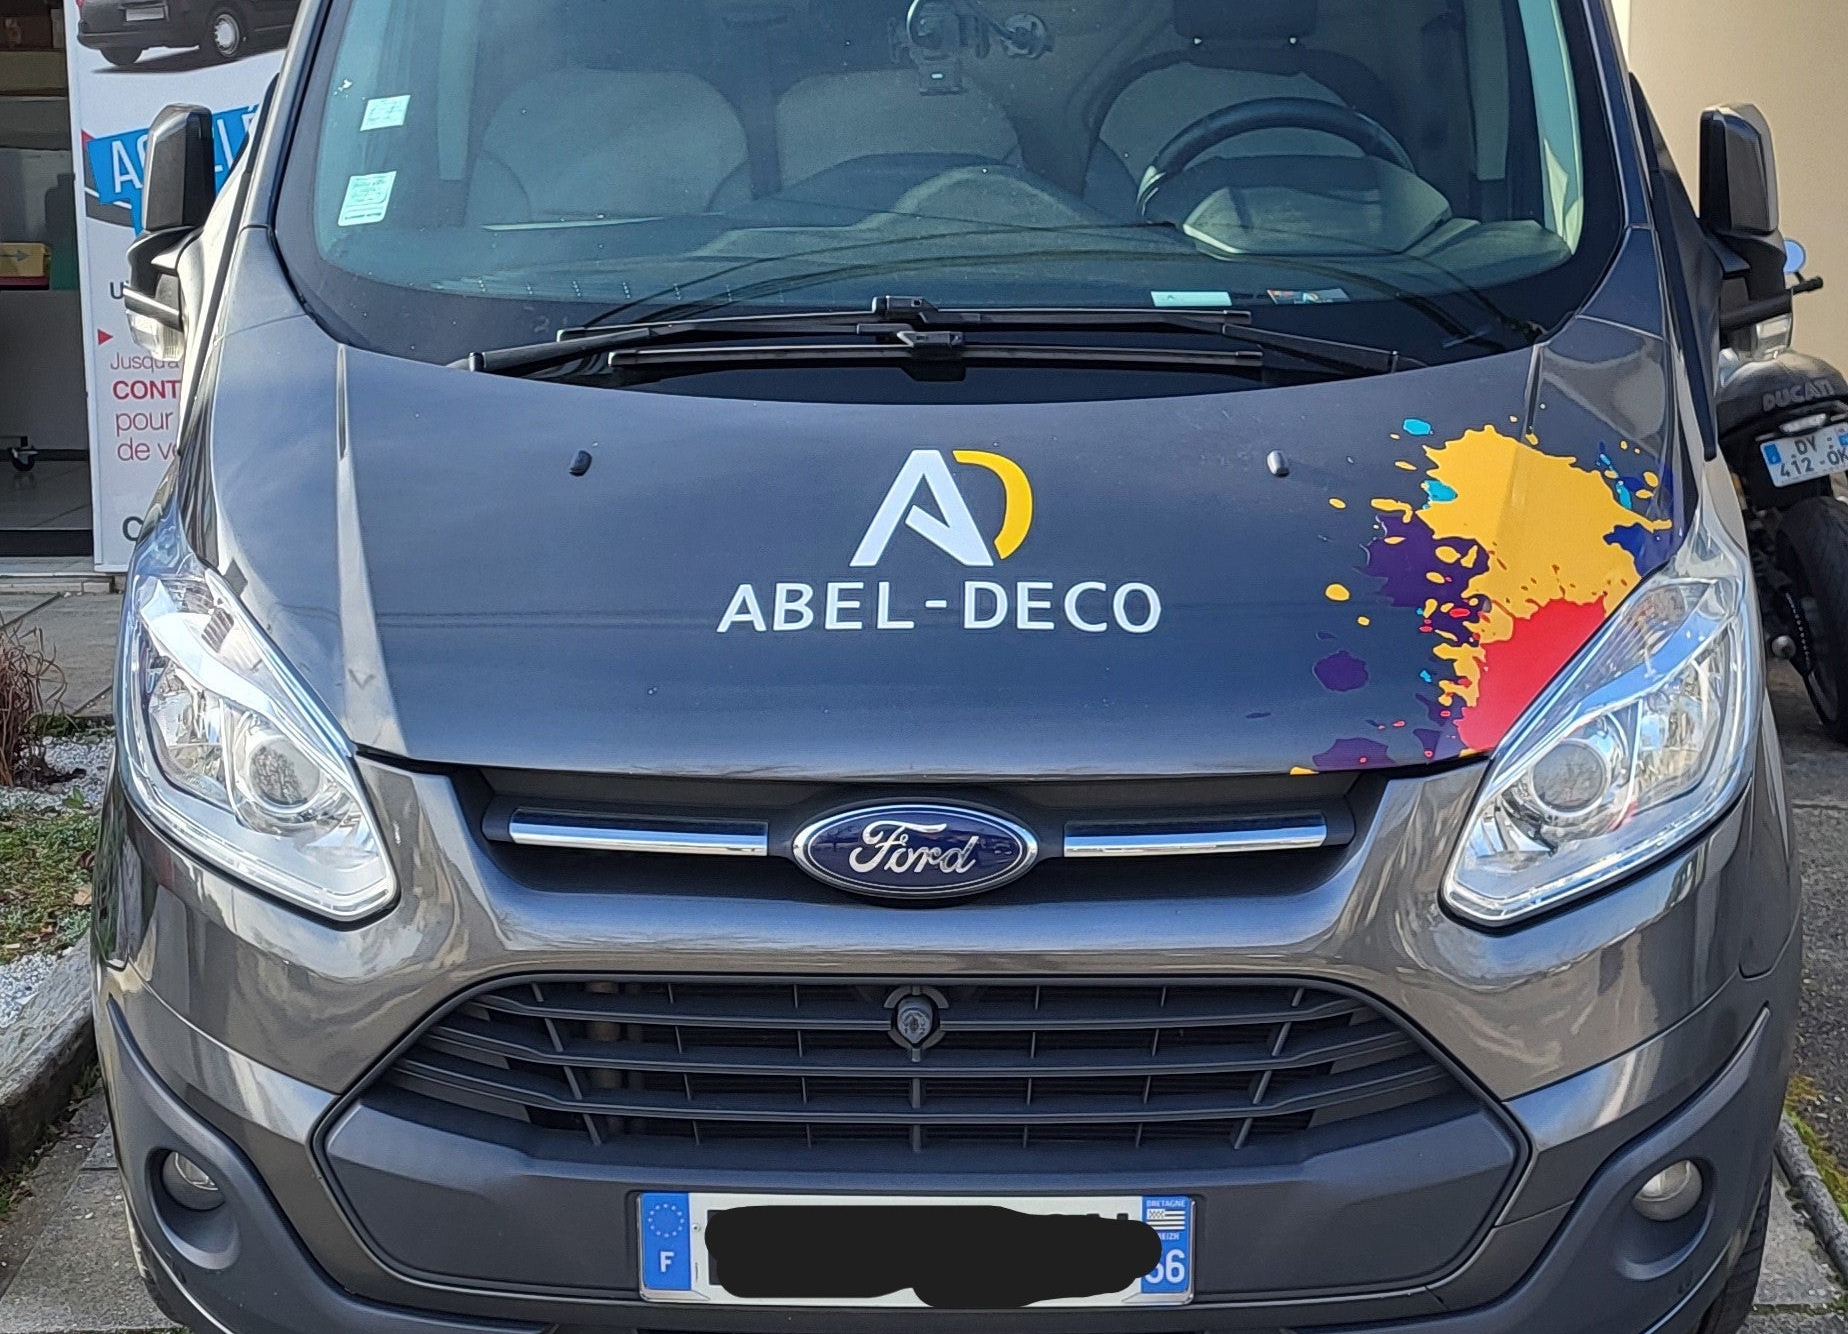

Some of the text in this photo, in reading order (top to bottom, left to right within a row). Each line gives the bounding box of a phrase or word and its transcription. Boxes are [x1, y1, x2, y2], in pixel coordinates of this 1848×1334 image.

[112, 380, 182, 400] CONT
[1762, 378, 1835, 411] DUCATI
[115, 411, 174, 437] pour
[117, 437, 150, 461] de
[716, 581, 1162, 633] ABEL-DECO
[848, 820, 981, 874] Ford
[660, 1251, 675, 1273] F
